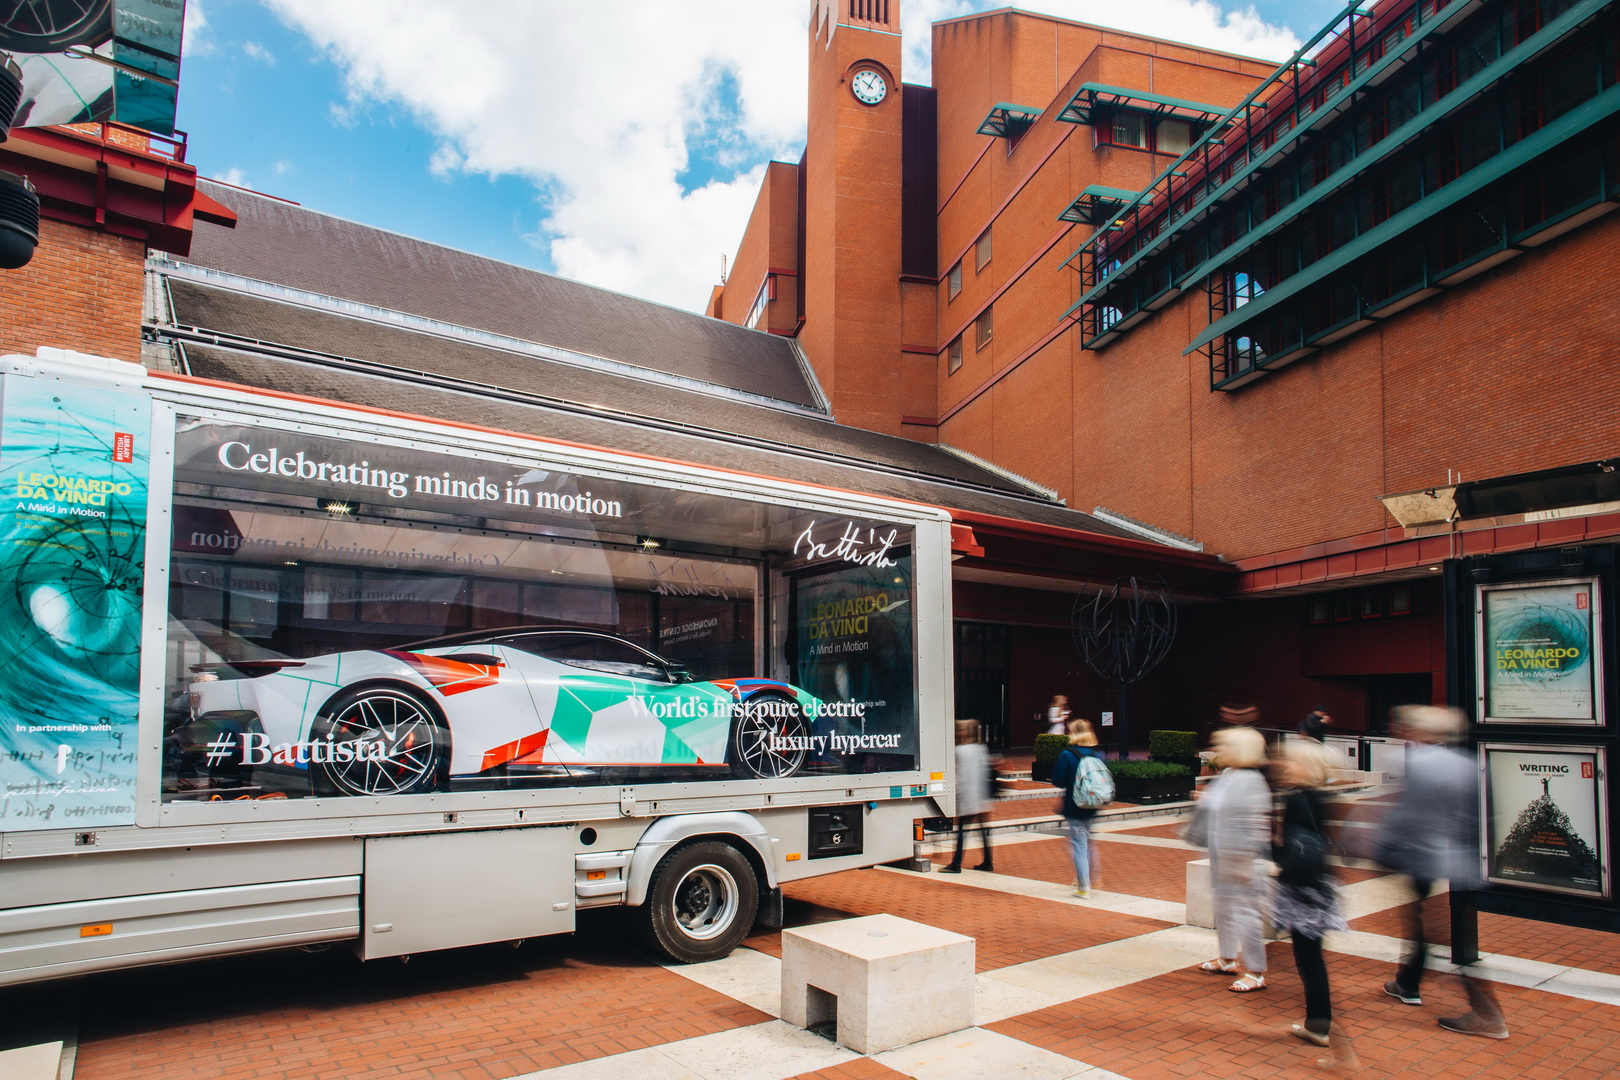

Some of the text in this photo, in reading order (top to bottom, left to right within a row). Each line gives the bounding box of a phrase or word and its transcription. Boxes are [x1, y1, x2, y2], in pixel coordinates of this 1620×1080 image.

[123, 434, 131, 459] LIBRARY
[18, 471, 131, 496] LEONARDO
[218, 441, 409, 498] Celebrating
[414, 472, 499, 501] minds
[504, 480, 530, 507] in
[536, 491, 622, 518] motion
[17, 485, 106, 507] DA VINCI
[16, 501, 106, 518] A Mind in Motion
[809, 593, 888, 622] LEONARDO
[809, 615, 869, 640] DA VINCI
[810, 640, 869, 656] A Mind in Motion
[1496, 647, 1579, 659] LEONARDO
[1497, 658, 1559, 669] DA VINCI
[1504, 670, 1524, 678] Mind
[1533, 670, 1560, 678] Motion
[625, 694, 865, 725] World's first pure electric
[16, 723, 112, 733] In partnership with
[206, 732, 390, 767] #Battista
[768, 729, 901, 756] luxury hypercar
[1519, 764, 1569, 773] WRITING
[0, 786, 119, 799] pininfarina
